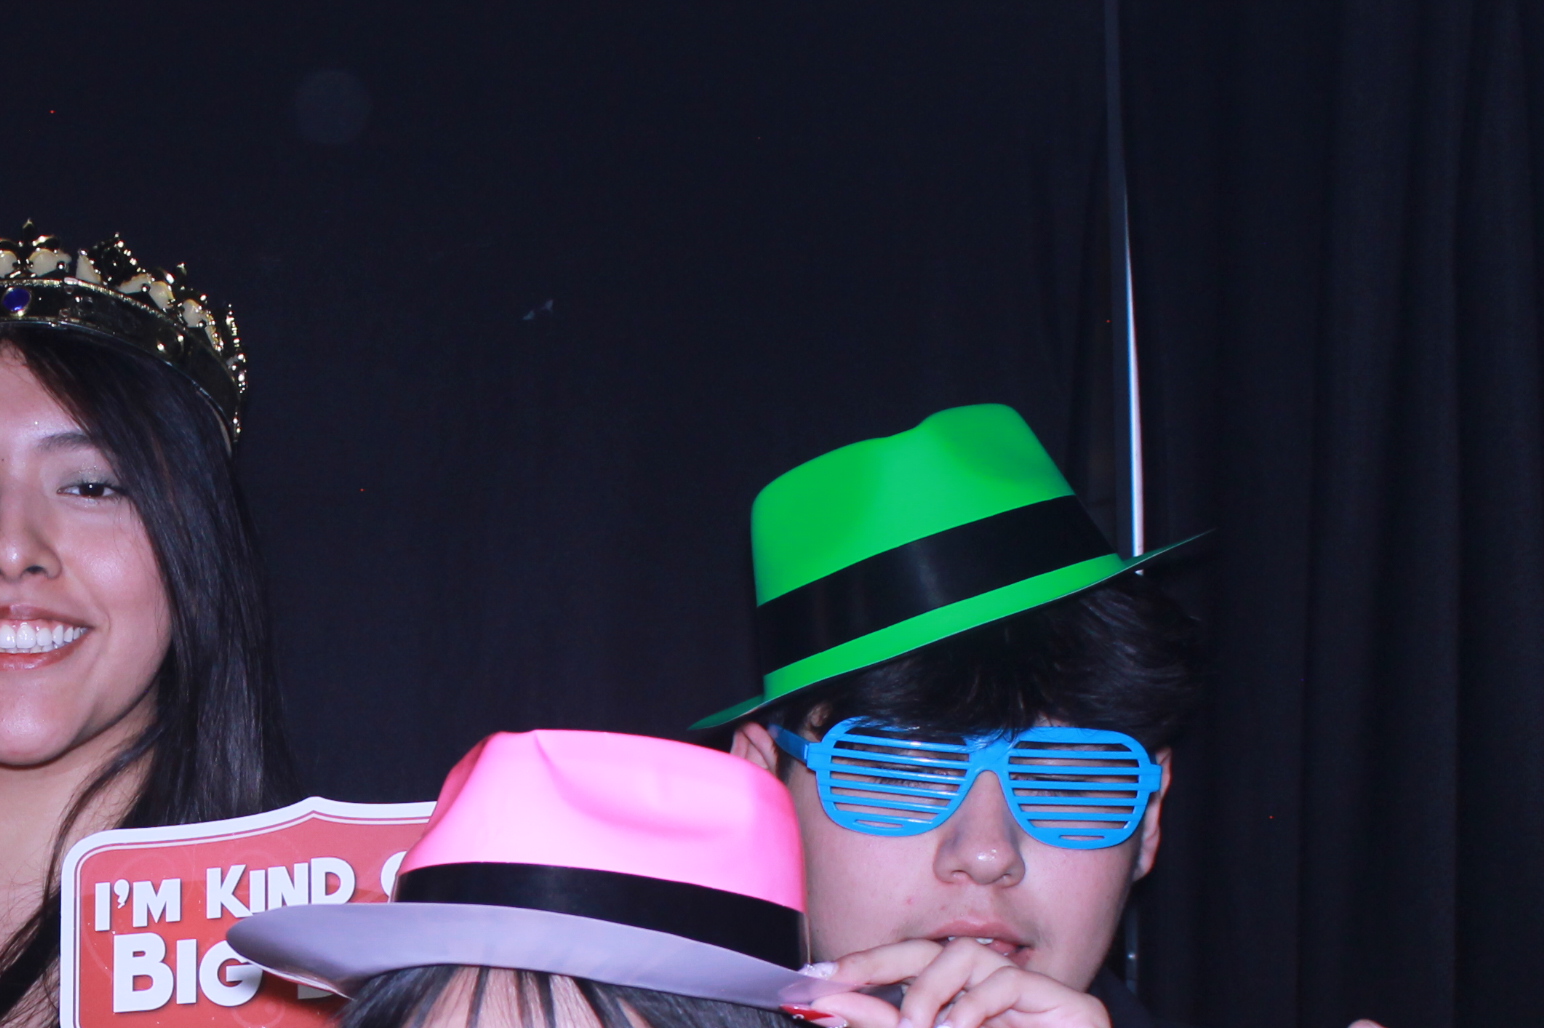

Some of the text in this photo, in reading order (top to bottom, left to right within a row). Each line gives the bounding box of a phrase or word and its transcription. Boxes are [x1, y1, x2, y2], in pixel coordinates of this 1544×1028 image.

[94, 877, 182, 932] I'M
[206, 856, 356, 919] KIND
[113, 932, 263, 1014] BIG
